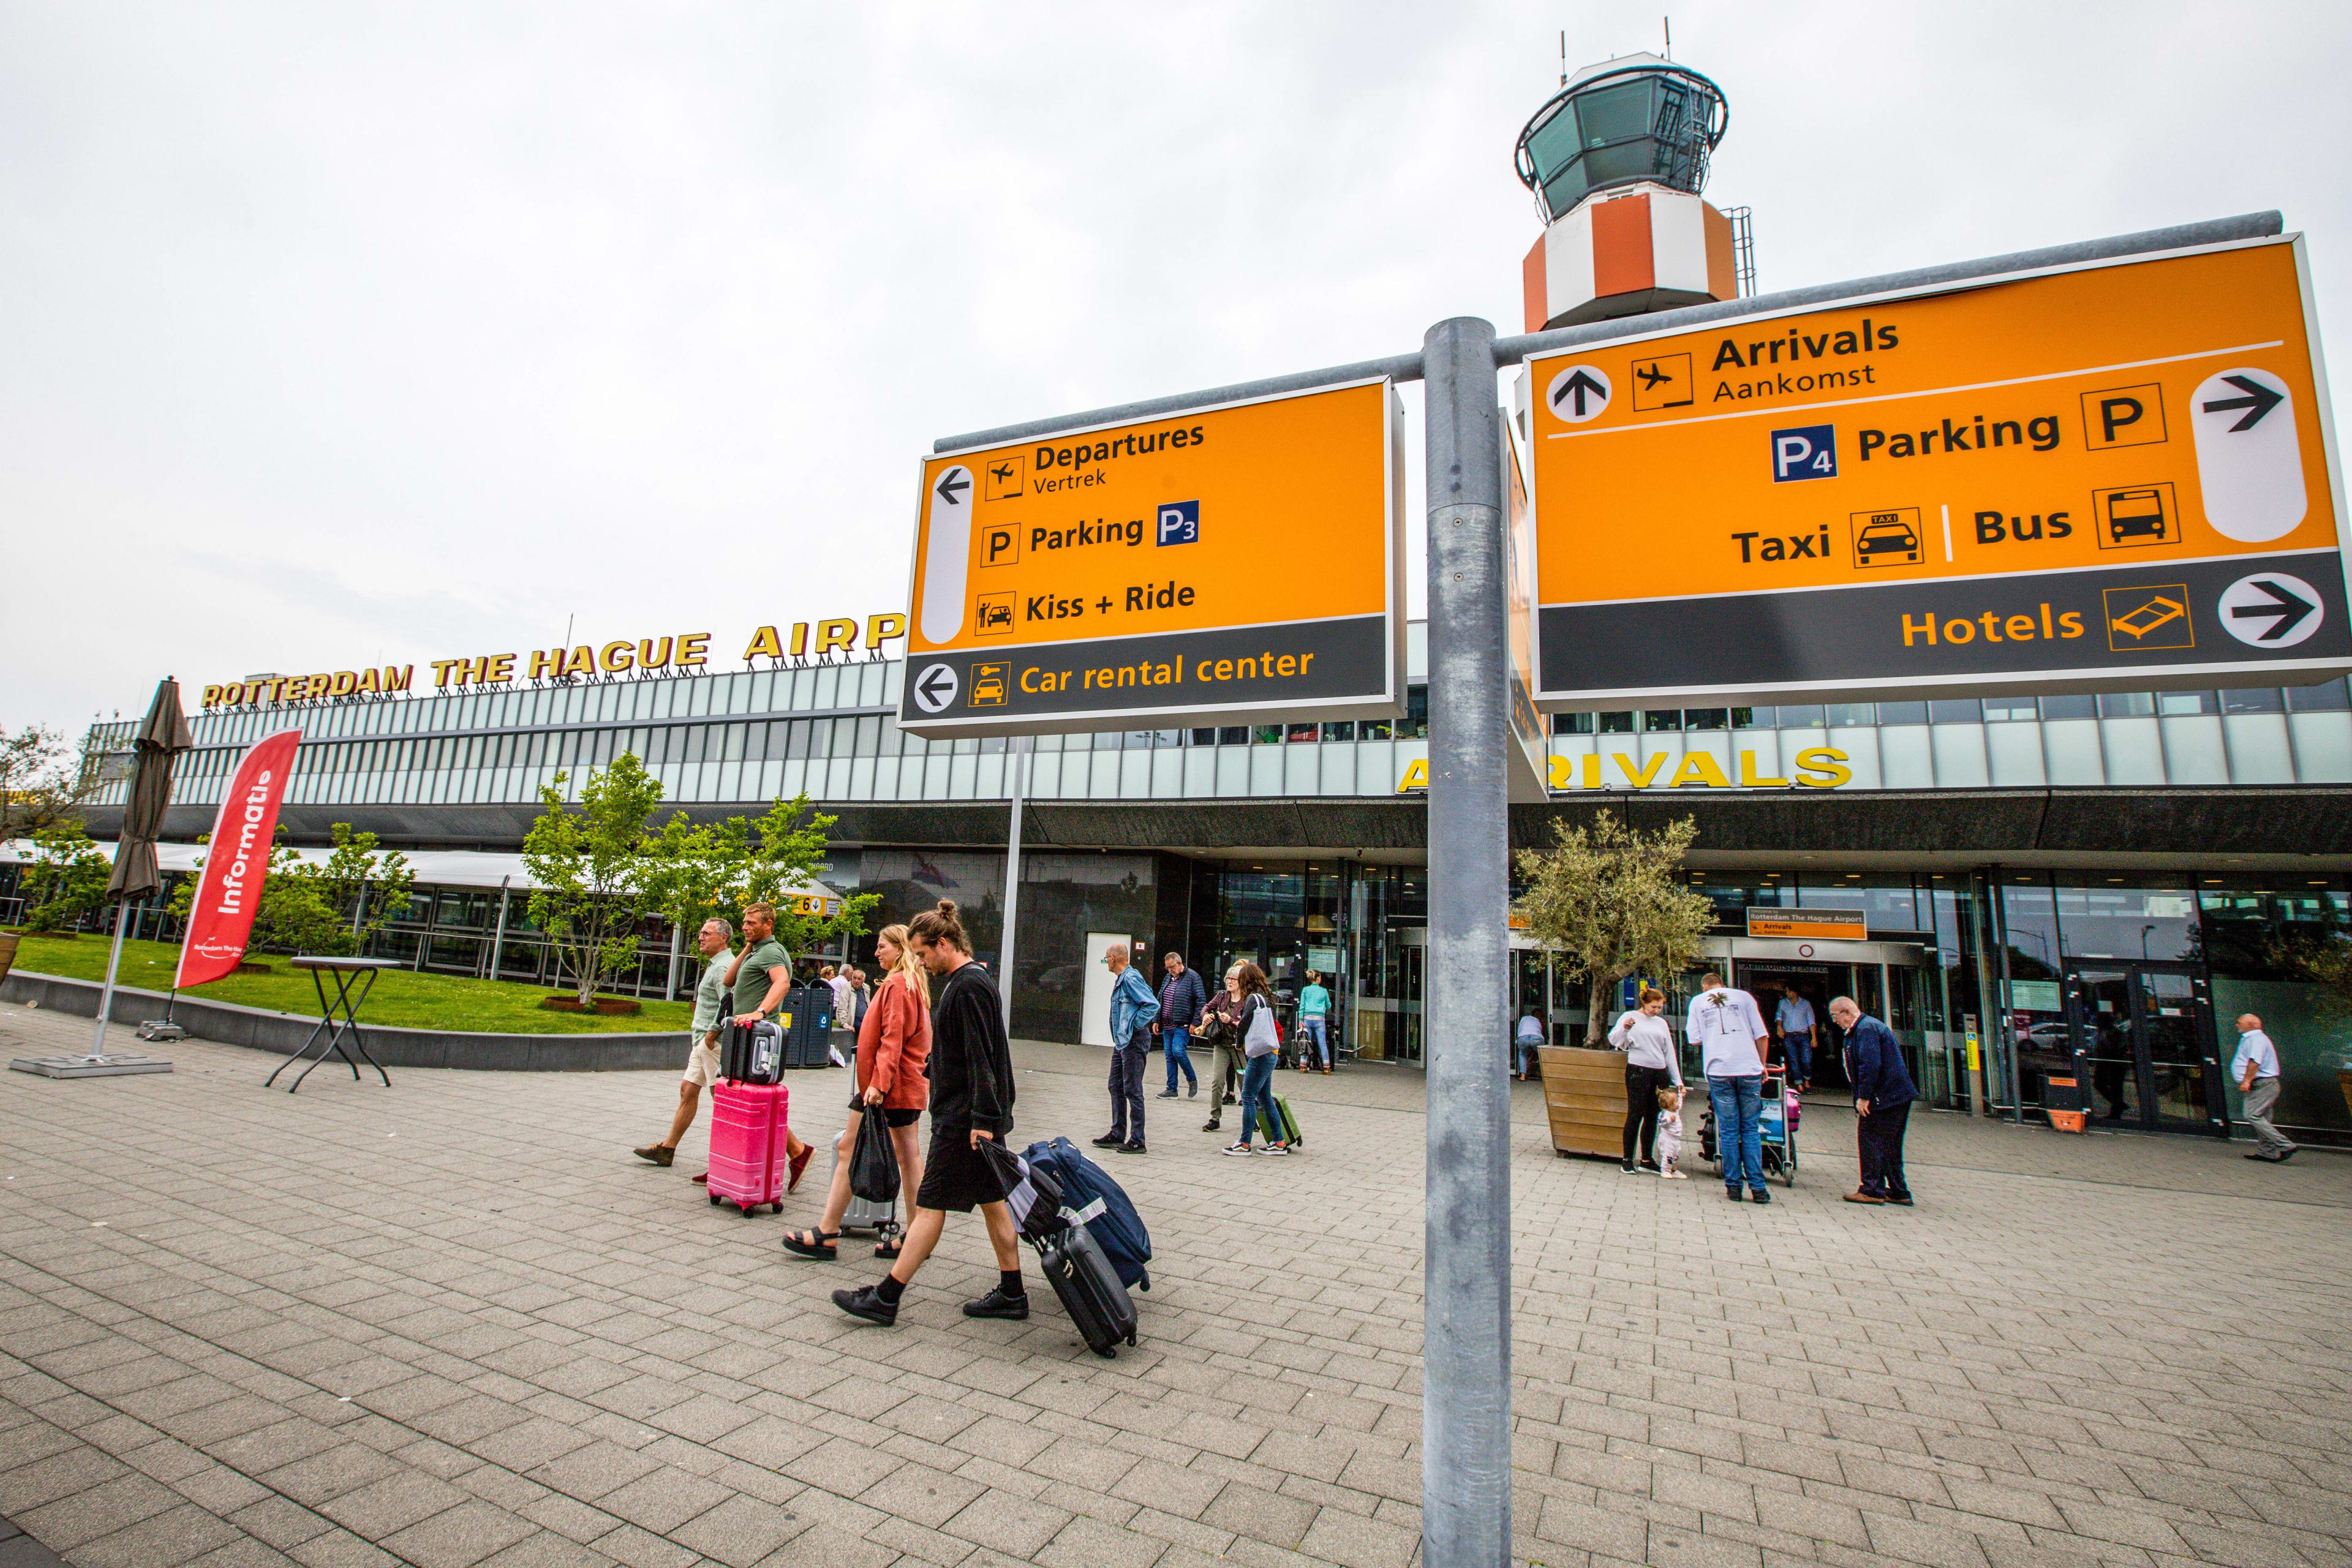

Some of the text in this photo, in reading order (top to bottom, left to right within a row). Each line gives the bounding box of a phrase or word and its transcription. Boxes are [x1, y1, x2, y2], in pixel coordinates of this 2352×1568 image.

[1711, 319, 1899, 372] Arrivals
[1712, 364, 1876, 403] Aankomst
[1035, 426, 1204, 471] Departures
[1777, 397, 2144, 478] P4 Parking P
[1033, 468, 1107, 495] Vertrek
[989, 509, 1196, 562] P Parking P3
[1732, 510, 2073, 564] Taxi Bus
[1871, 514, 1898, 524] TAXI
[1027, 581, 1195, 622] Kiss + Ride
[1901, 603, 2085, 647] Hotels
[201, 665, 413, 708] ROTTERDAM
[430, 653, 517, 687] THE
[528, 632, 711, 680] HAGUE
[1020, 651, 1315, 693] Car rental center
[1398, 747, 1853, 792] ARIVALS
[217, 769, 271, 914] Informatie
[802, 897, 810, 911] 6
